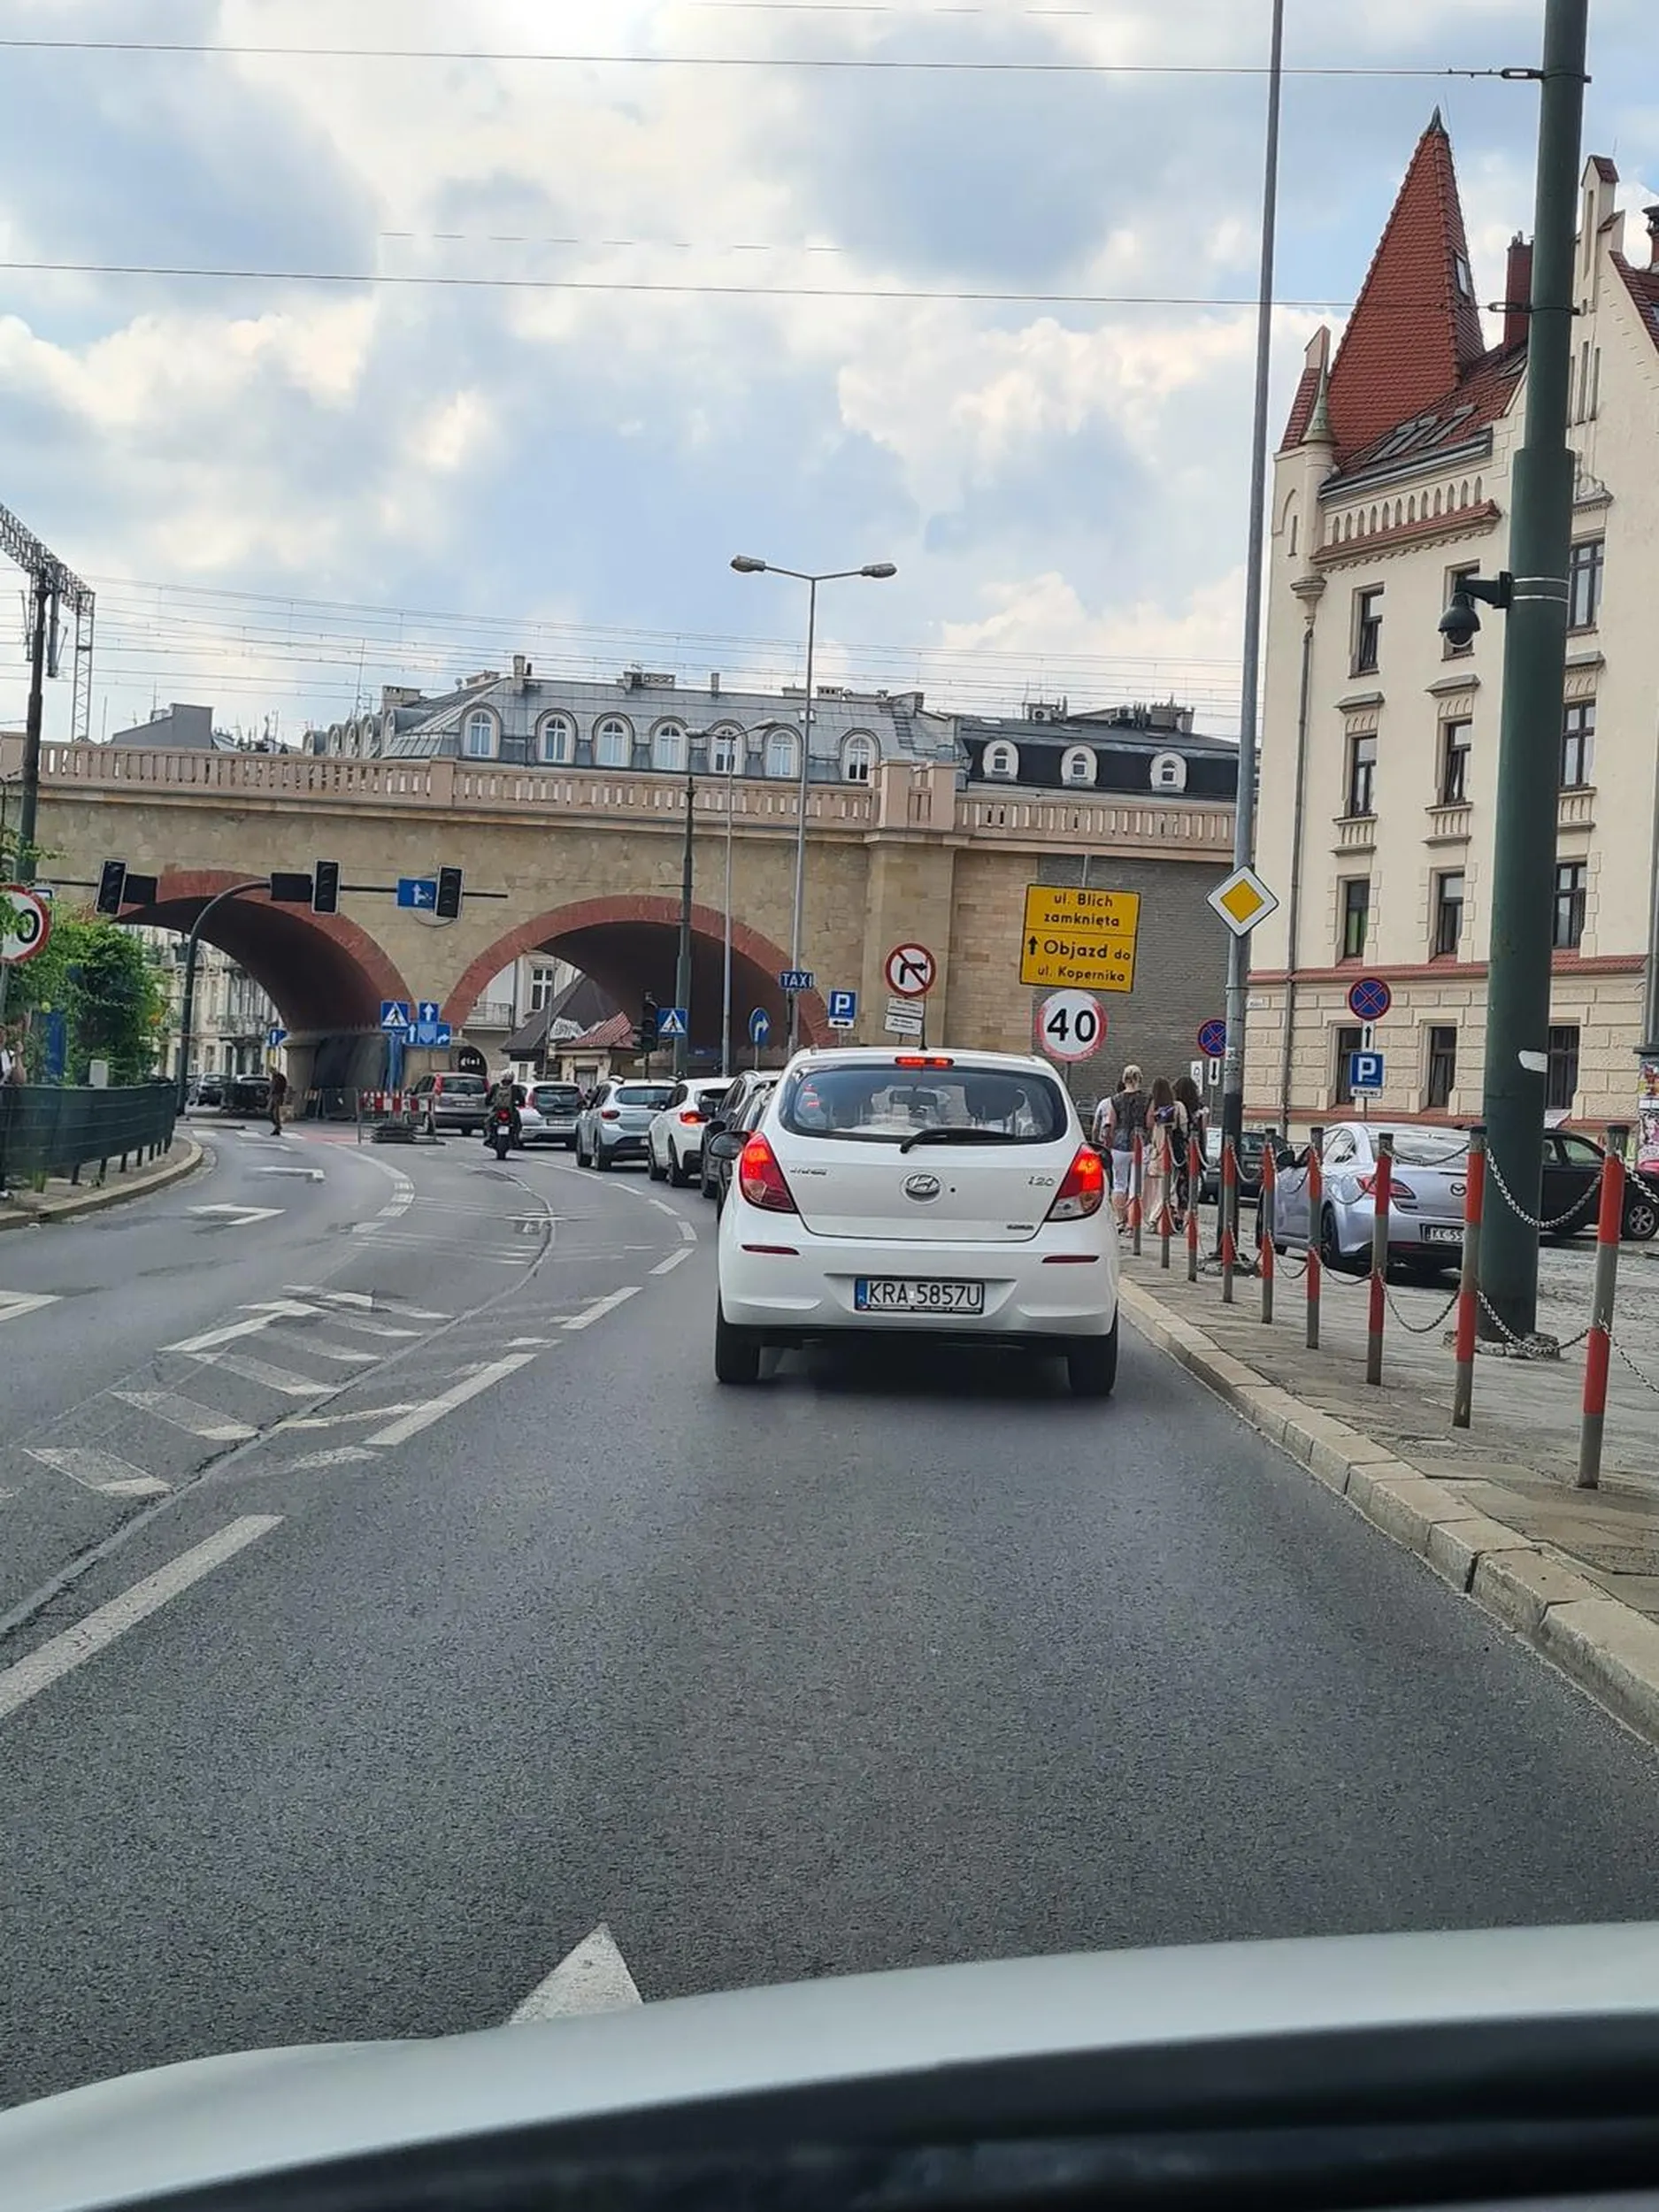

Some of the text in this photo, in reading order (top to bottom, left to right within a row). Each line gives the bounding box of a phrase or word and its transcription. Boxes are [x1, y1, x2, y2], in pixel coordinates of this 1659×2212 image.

[1054, 893, 1113, 907] ul. Blich
[1044, 912, 1120, 928] zamknięta
[1043, 939, 1132, 961] Objazd do
[782, 973, 813, 988] TAXI
[834, 994, 850, 1015] P
[1046, 1008, 1096, 1042] 40
[1357, 1056, 1377, 1082] P
[868, 1281, 980, 1307] KRA 5857U
